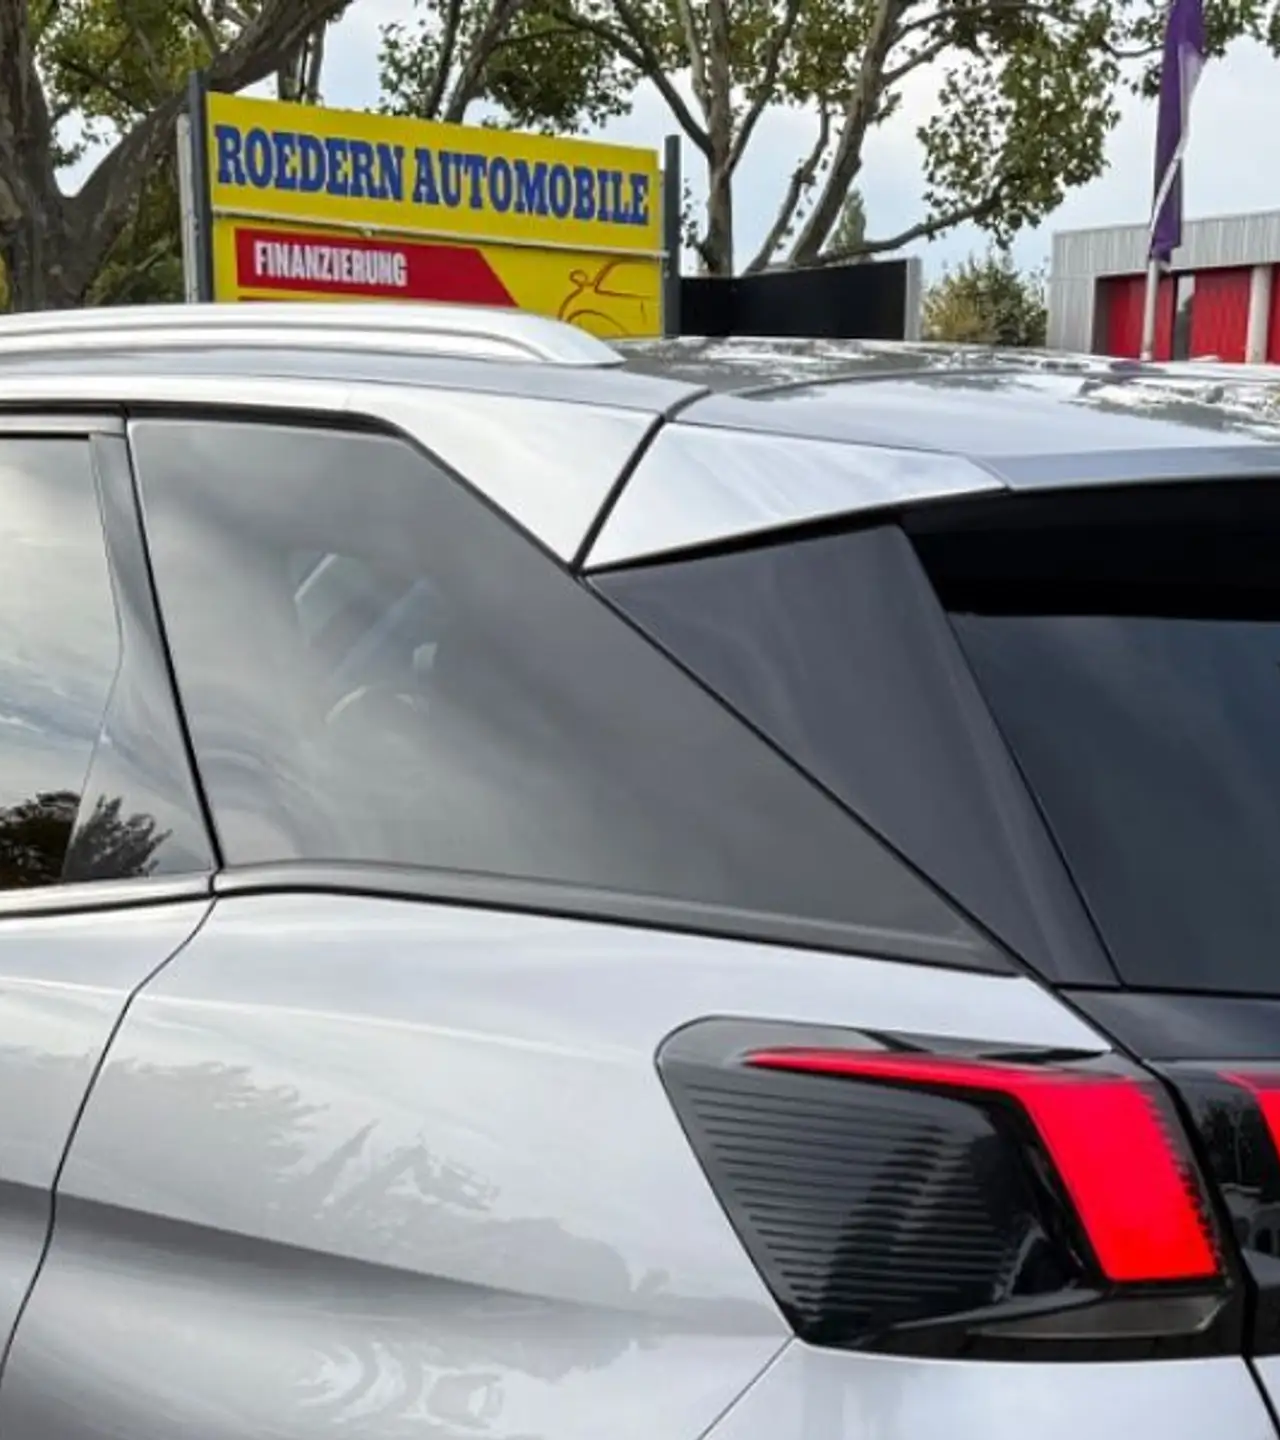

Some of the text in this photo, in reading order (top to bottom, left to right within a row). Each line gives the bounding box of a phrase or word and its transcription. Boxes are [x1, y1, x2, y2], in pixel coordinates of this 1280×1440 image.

[214, 124, 649, 226] ROEDERN AUTOMOBILE
[253, 240, 408, 287] FINANZIERUNG
